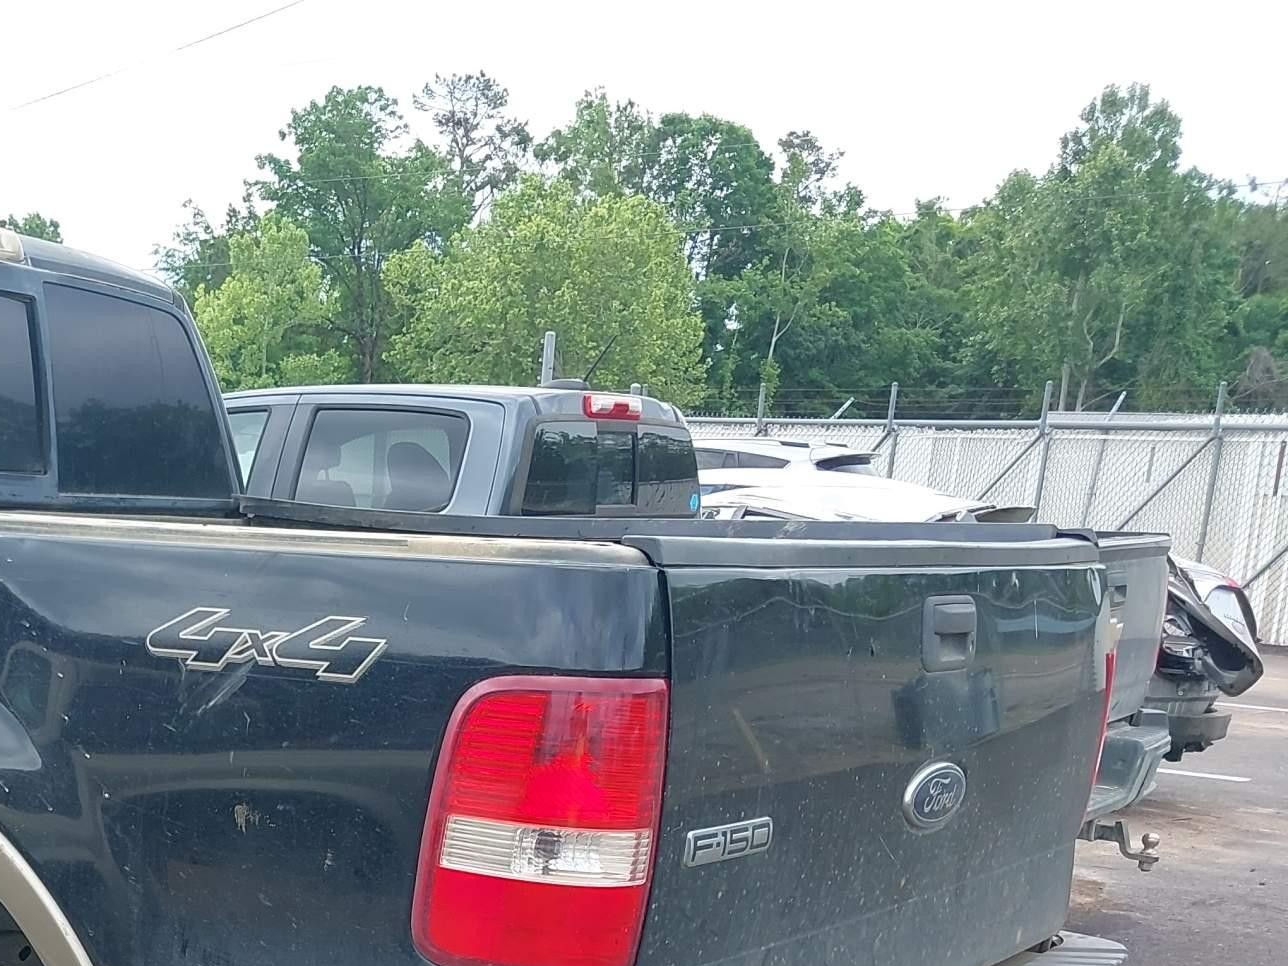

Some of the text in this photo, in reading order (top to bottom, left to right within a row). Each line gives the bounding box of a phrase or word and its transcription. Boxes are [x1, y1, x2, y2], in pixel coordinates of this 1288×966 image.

[146, 607, 389, 683] 4x4
[923, 776, 958, 813] Ford
[689, 818, 772, 864] F-150
